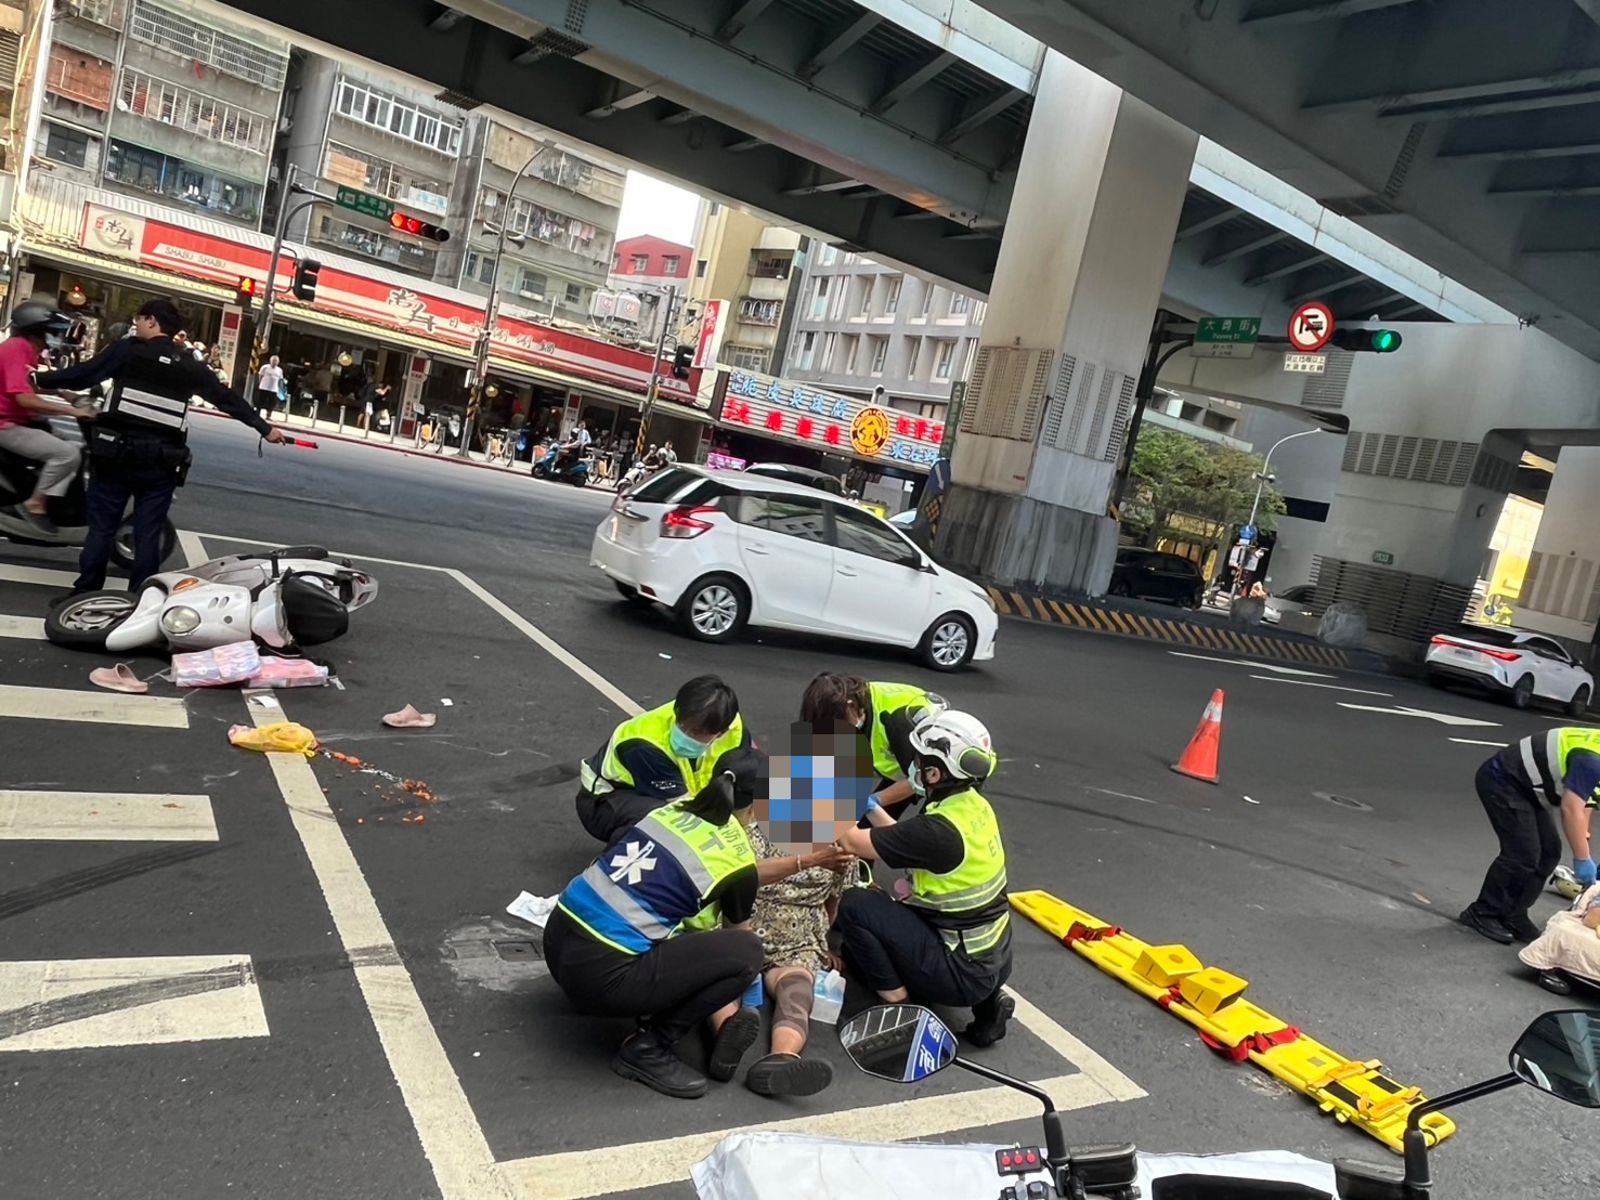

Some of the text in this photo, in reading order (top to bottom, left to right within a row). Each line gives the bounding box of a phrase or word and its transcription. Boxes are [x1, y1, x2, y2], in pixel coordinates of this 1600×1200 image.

[165, 246, 227, 269] SHABU SHABU
[719, 823, 749, 856] 防局
